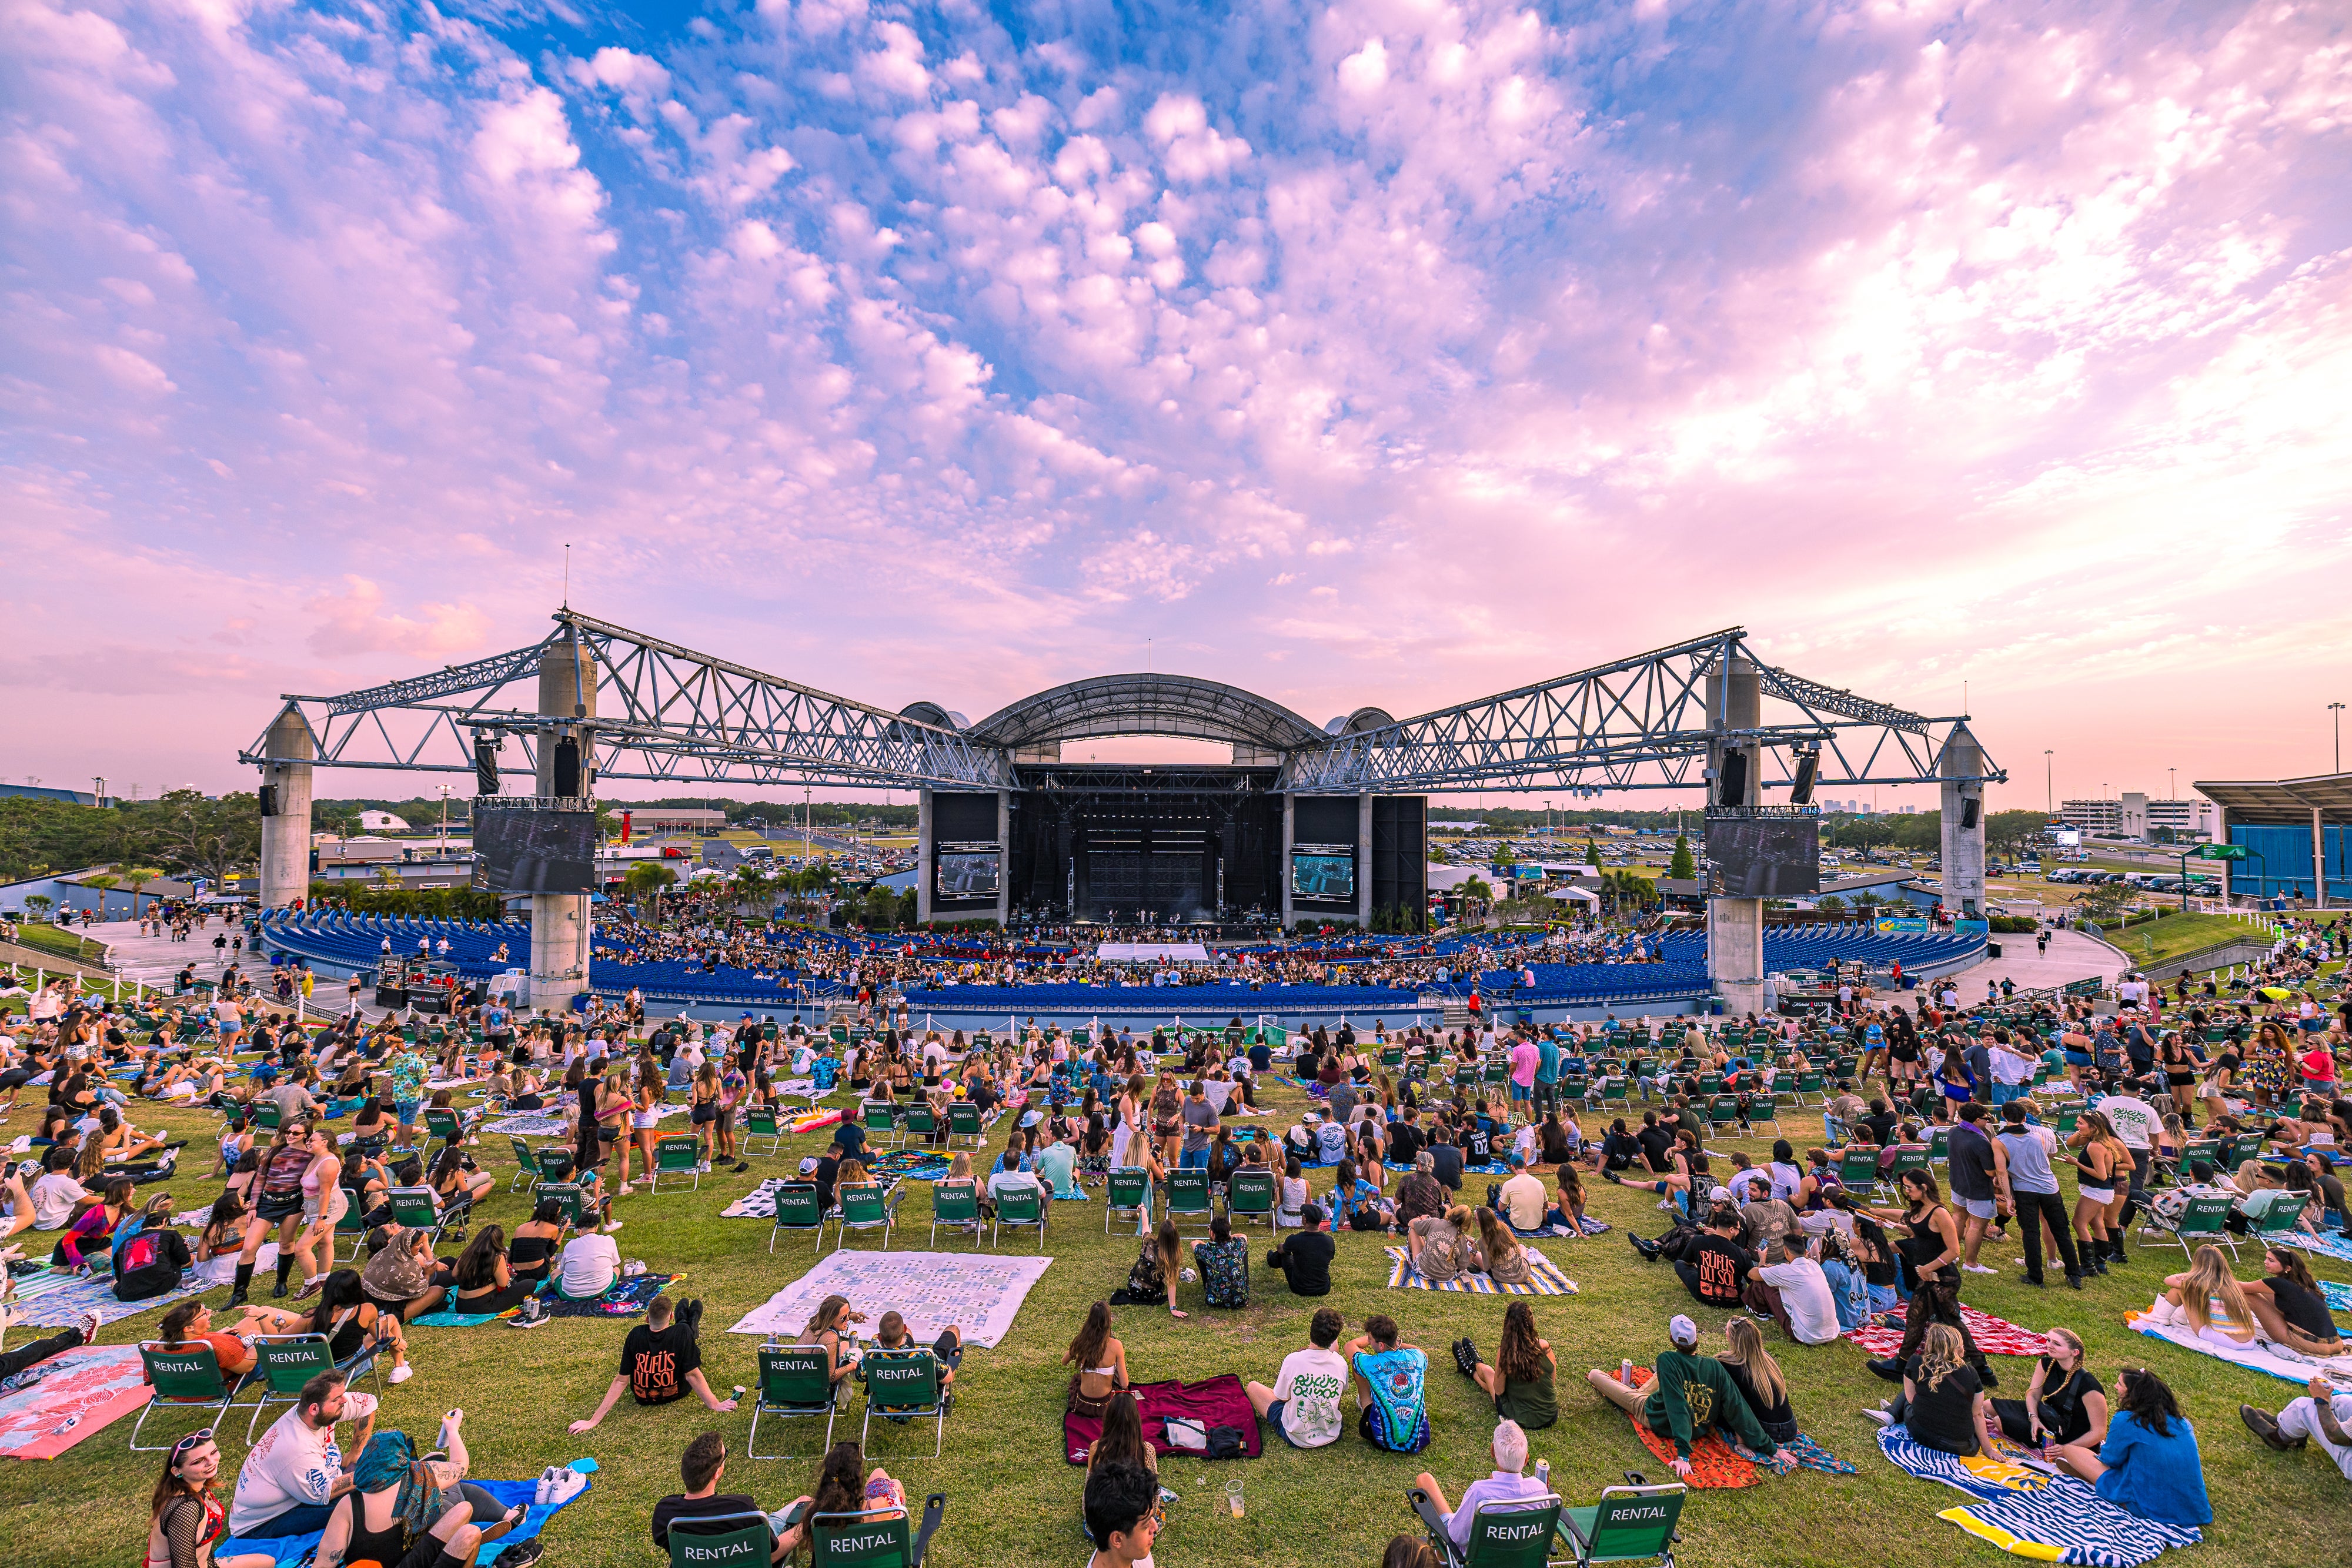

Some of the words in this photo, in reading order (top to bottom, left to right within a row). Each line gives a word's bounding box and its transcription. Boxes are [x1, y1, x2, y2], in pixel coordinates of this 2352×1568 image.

[1474, 1140, 1489, 1155] 02
[1699, 1249, 1735, 1274] RÜFÜS
[1700, 1265, 1716, 1282] DU
[1718, 1270, 1736, 1287] SOL
[269, 1352, 319, 1362] RENTAL
[635, 1351, 676, 1373] RÜFÜS
[154, 1361, 203, 1372] RENTAL
[771, 1361, 817, 1370] RENTAL
[877, 1368, 923, 1379] RENTAL
[634, 1369, 649, 1388] DU
[653, 1370, 677, 1388] SOL
[310, 1473, 328, 1489] DAY
[1611, 1506, 1666, 1520] RENTAL
[1487, 1523, 1544, 1539] RENTAL
[686, 1542, 753, 1559] RENTAL
[831, 1533, 896, 1552] RENTAL
